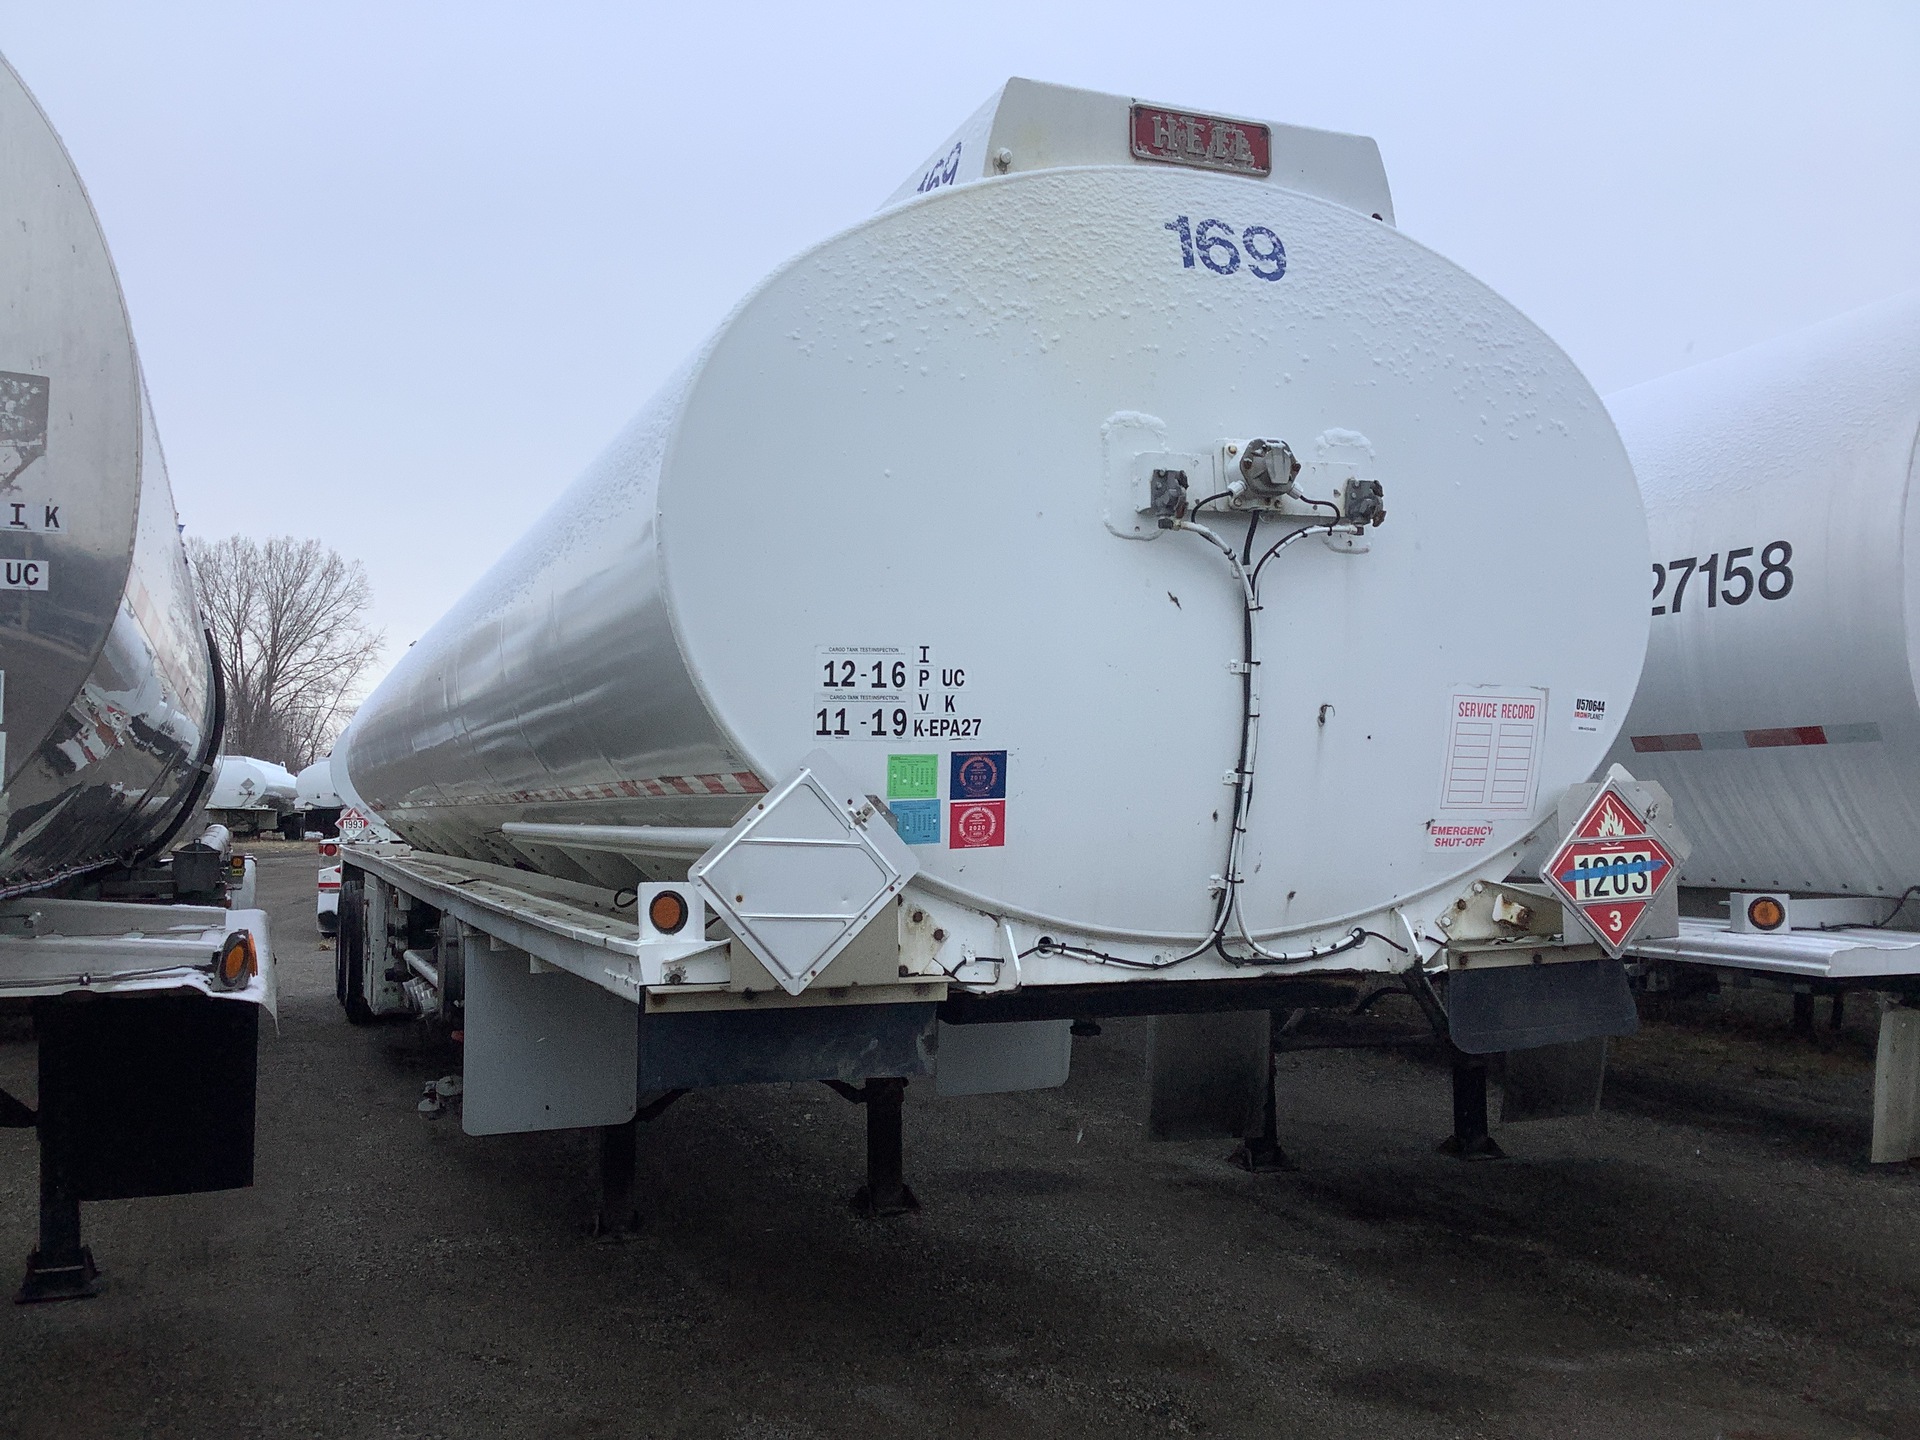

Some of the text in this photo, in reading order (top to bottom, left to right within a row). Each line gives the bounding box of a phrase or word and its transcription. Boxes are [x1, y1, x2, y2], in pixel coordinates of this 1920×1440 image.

[1165, 215, 1287, 281] 169
[45, 505, 60, 528] K
[6, 563, 39, 586] UC
[823, 660, 906, 688] 12-16
[919, 669, 965, 687] P UC
[918, 694, 956, 712] V K
[1458, 702, 1535, 719] SERVICE RECORD
[914, 719, 982, 737] K-EPA27
[345, 820, 362, 828] 1993
[1431, 826, 1493, 836] EMERGENCY
[1435, 838, 1485, 847] SHUT-OFF
[1579, 854, 1648, 898] 1203
[1609, 910, 1622, 932] 3
